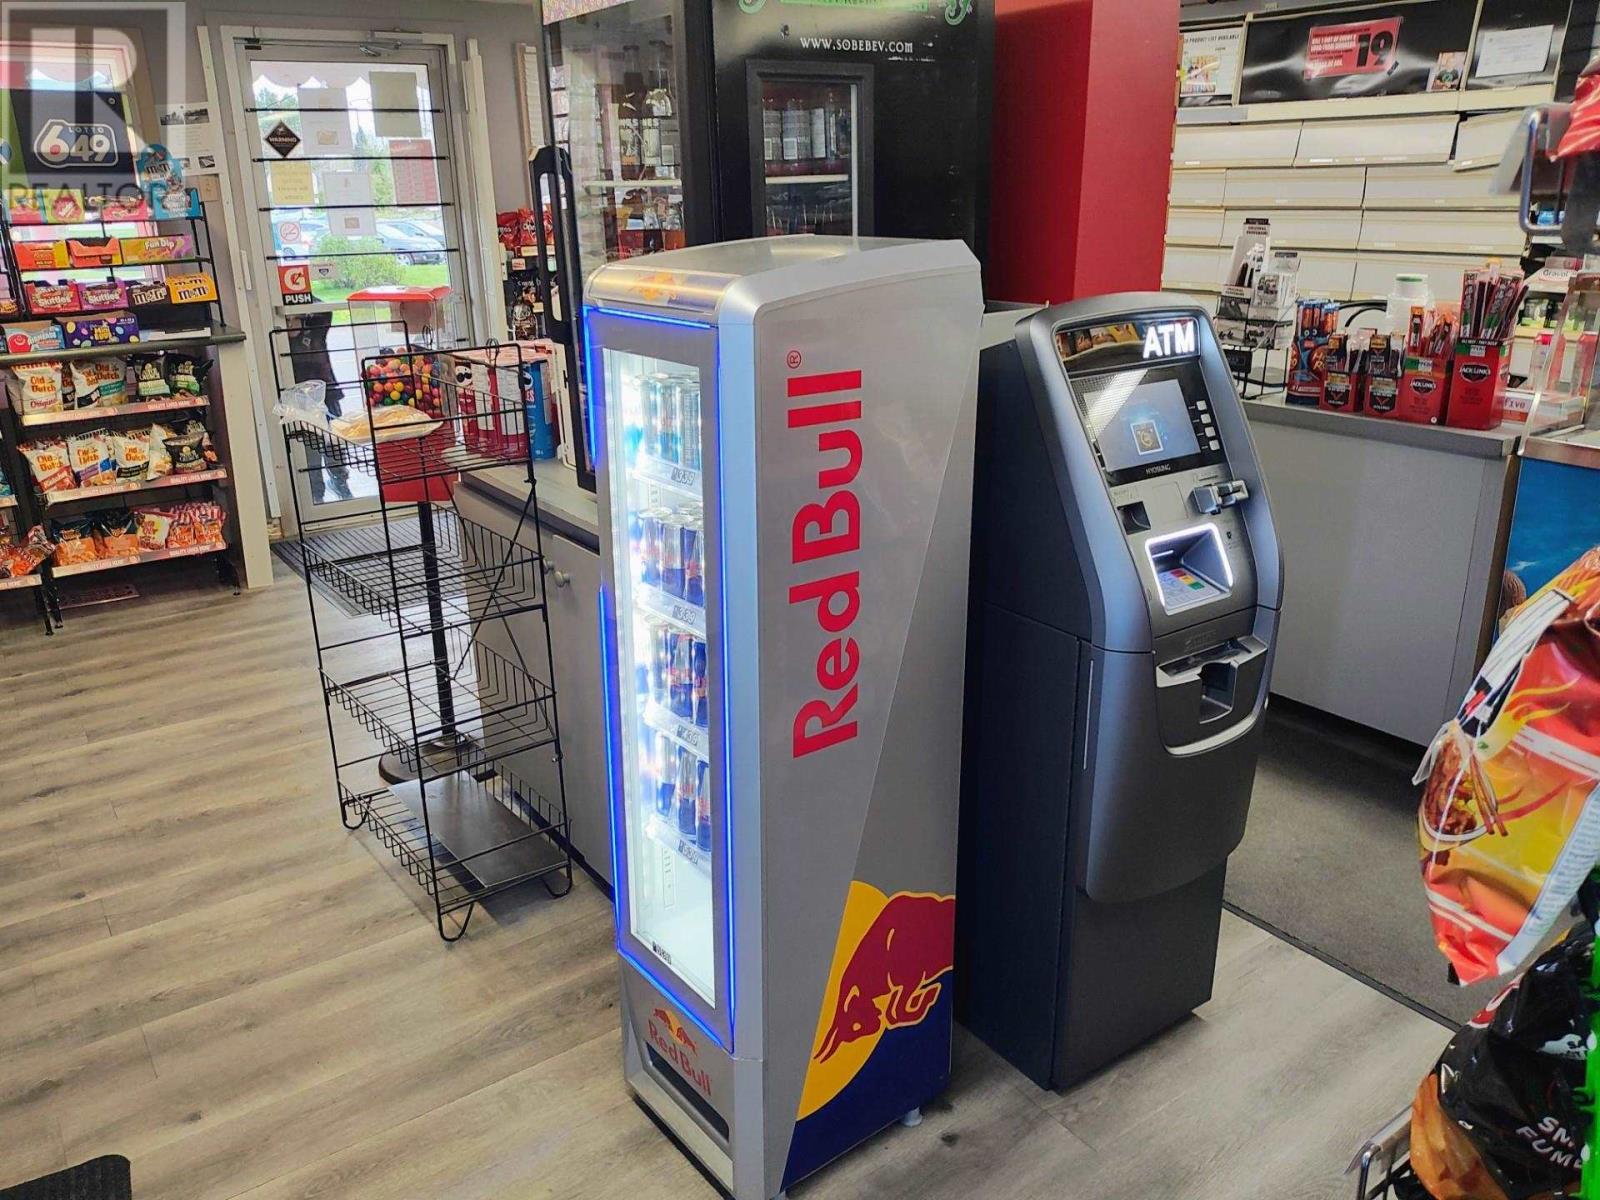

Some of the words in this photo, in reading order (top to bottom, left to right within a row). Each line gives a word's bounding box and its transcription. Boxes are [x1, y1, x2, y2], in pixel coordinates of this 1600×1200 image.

[800, 37, 913, 53] WWW.SOBEBEV.COM
[1357, 31, 1394, 67] 19
[68, 126, 105, 134] LOTTO
[145, 240, 160, 249] Fun
[160, 239, 175, 249] Dip
[37, 295, 71, 306] Skittles
[87, 292, 120, 303] Skittles
[285, 294, 311, 304] PUSH
[1143, 321, 1196, 358] ATM
[30, 376, 45, 385] Old
[31, 385, 56, 393] Dutch
[787, 370, 863, 565] Bull
[1145, 464, 1171, 474] HYOSUNG
[788, 571, 861, 758] Red
[647, 1019, 678, 1065] Red
[680, 1058, 712, 1097] Bull
